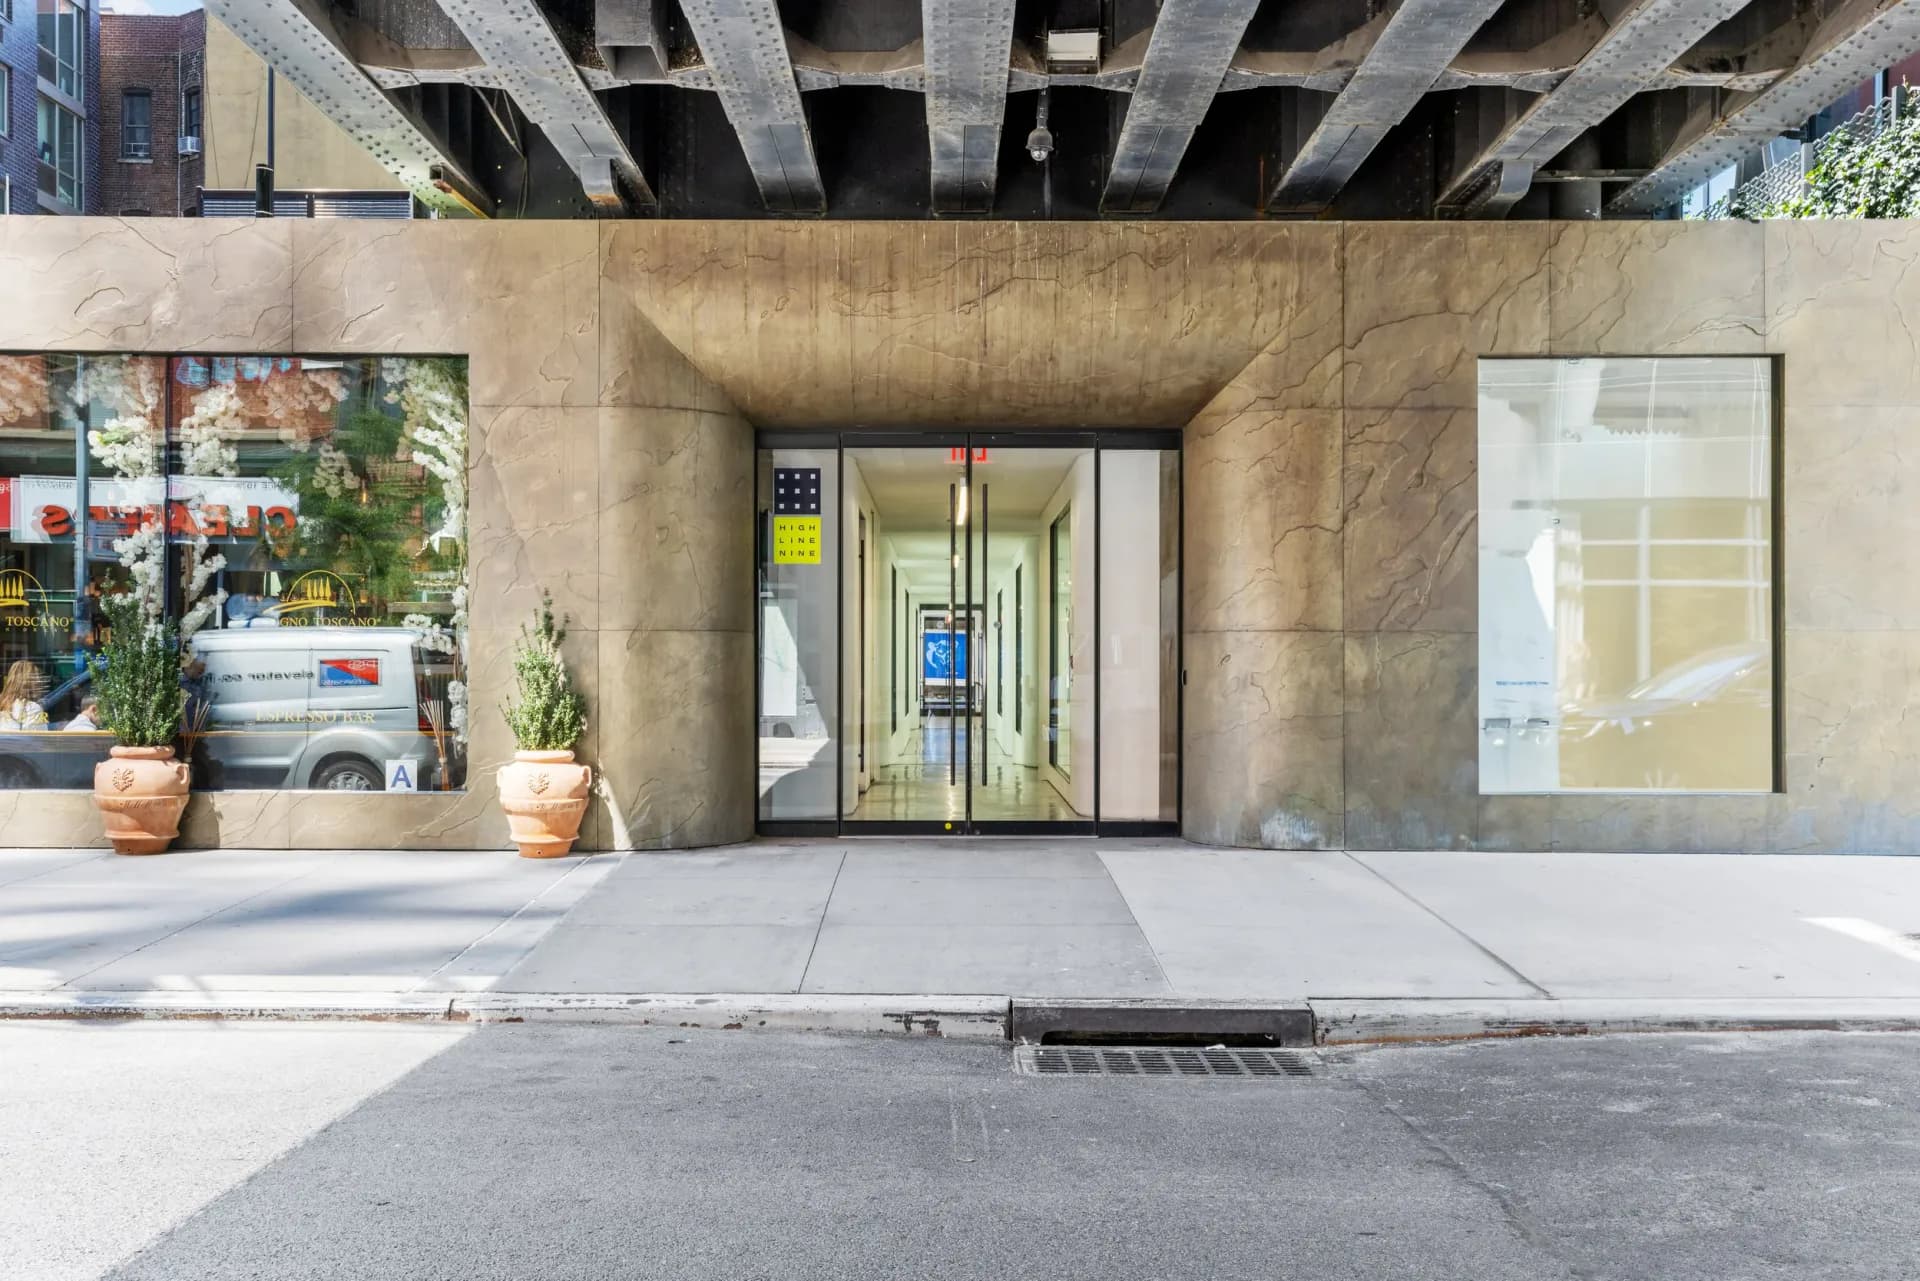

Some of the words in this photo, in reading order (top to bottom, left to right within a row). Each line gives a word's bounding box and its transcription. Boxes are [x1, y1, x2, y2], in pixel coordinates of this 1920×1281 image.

[256, 711, 338, 723] ESPRESSO
[343, 712, 376, 724] BAR
[391, 764, 412, 788] A
